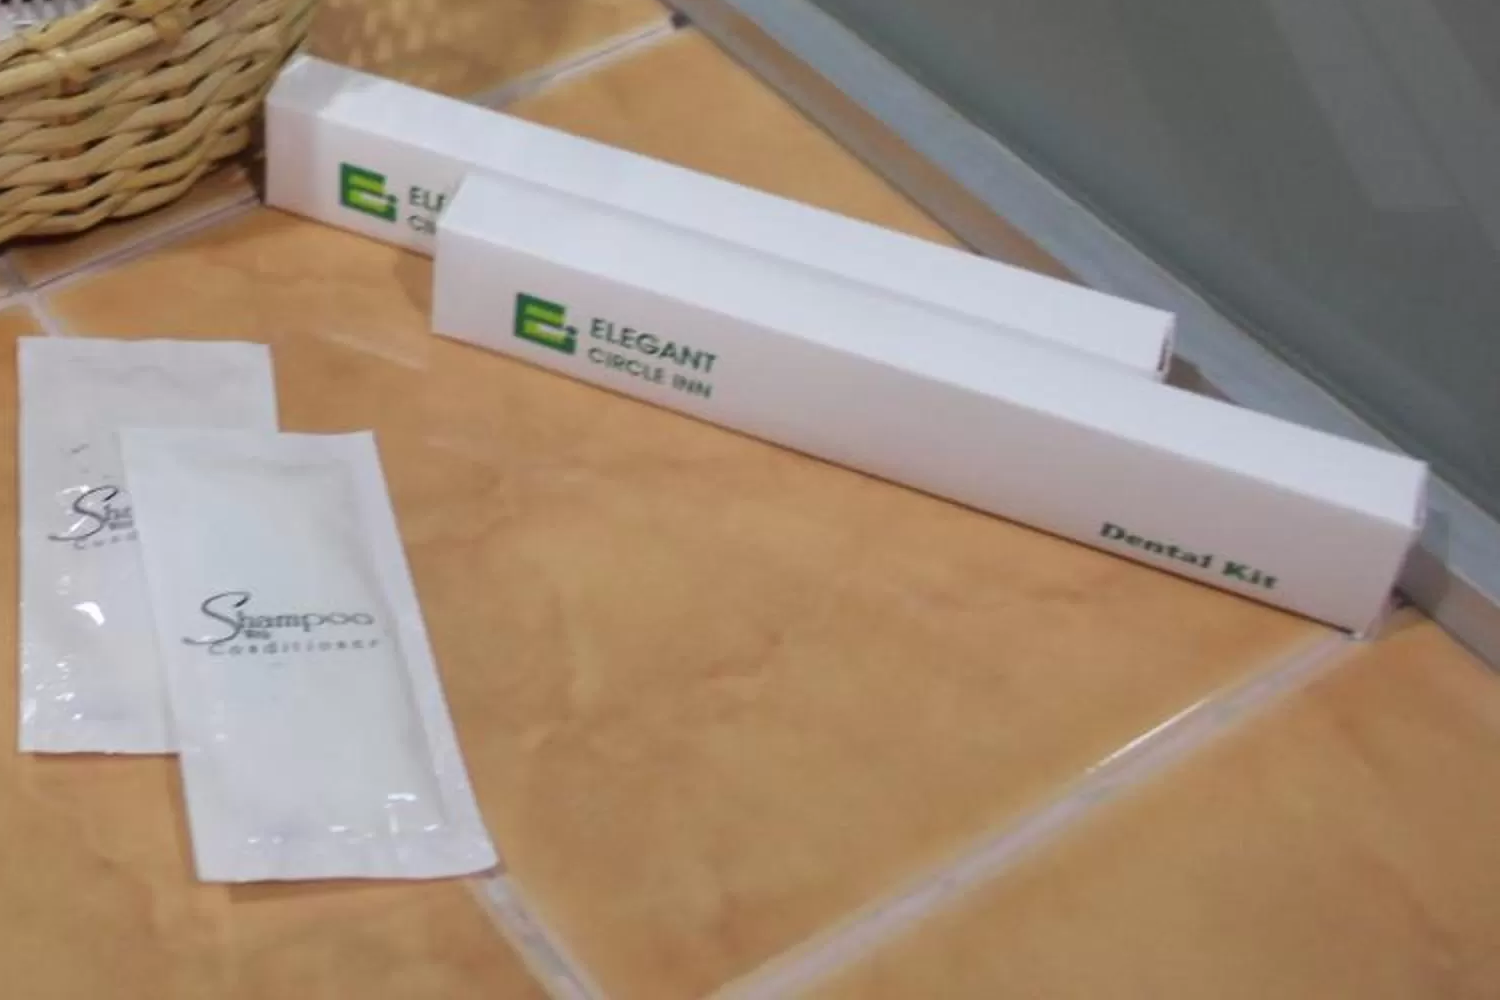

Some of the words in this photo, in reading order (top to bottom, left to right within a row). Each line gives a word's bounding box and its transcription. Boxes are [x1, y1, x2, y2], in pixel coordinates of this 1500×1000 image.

[589, 317, 717, 373] ELEGANT
[587, 347, 665, 385] CIRCLE
[671, 373, 713, 400] INN
[1099, 521, 1214, 569] Dental
[1222, 560, 1278, 590] Kit
[181, 591, 375, 645] Shampoo
[208, 639, 380, 656] Conditioner
